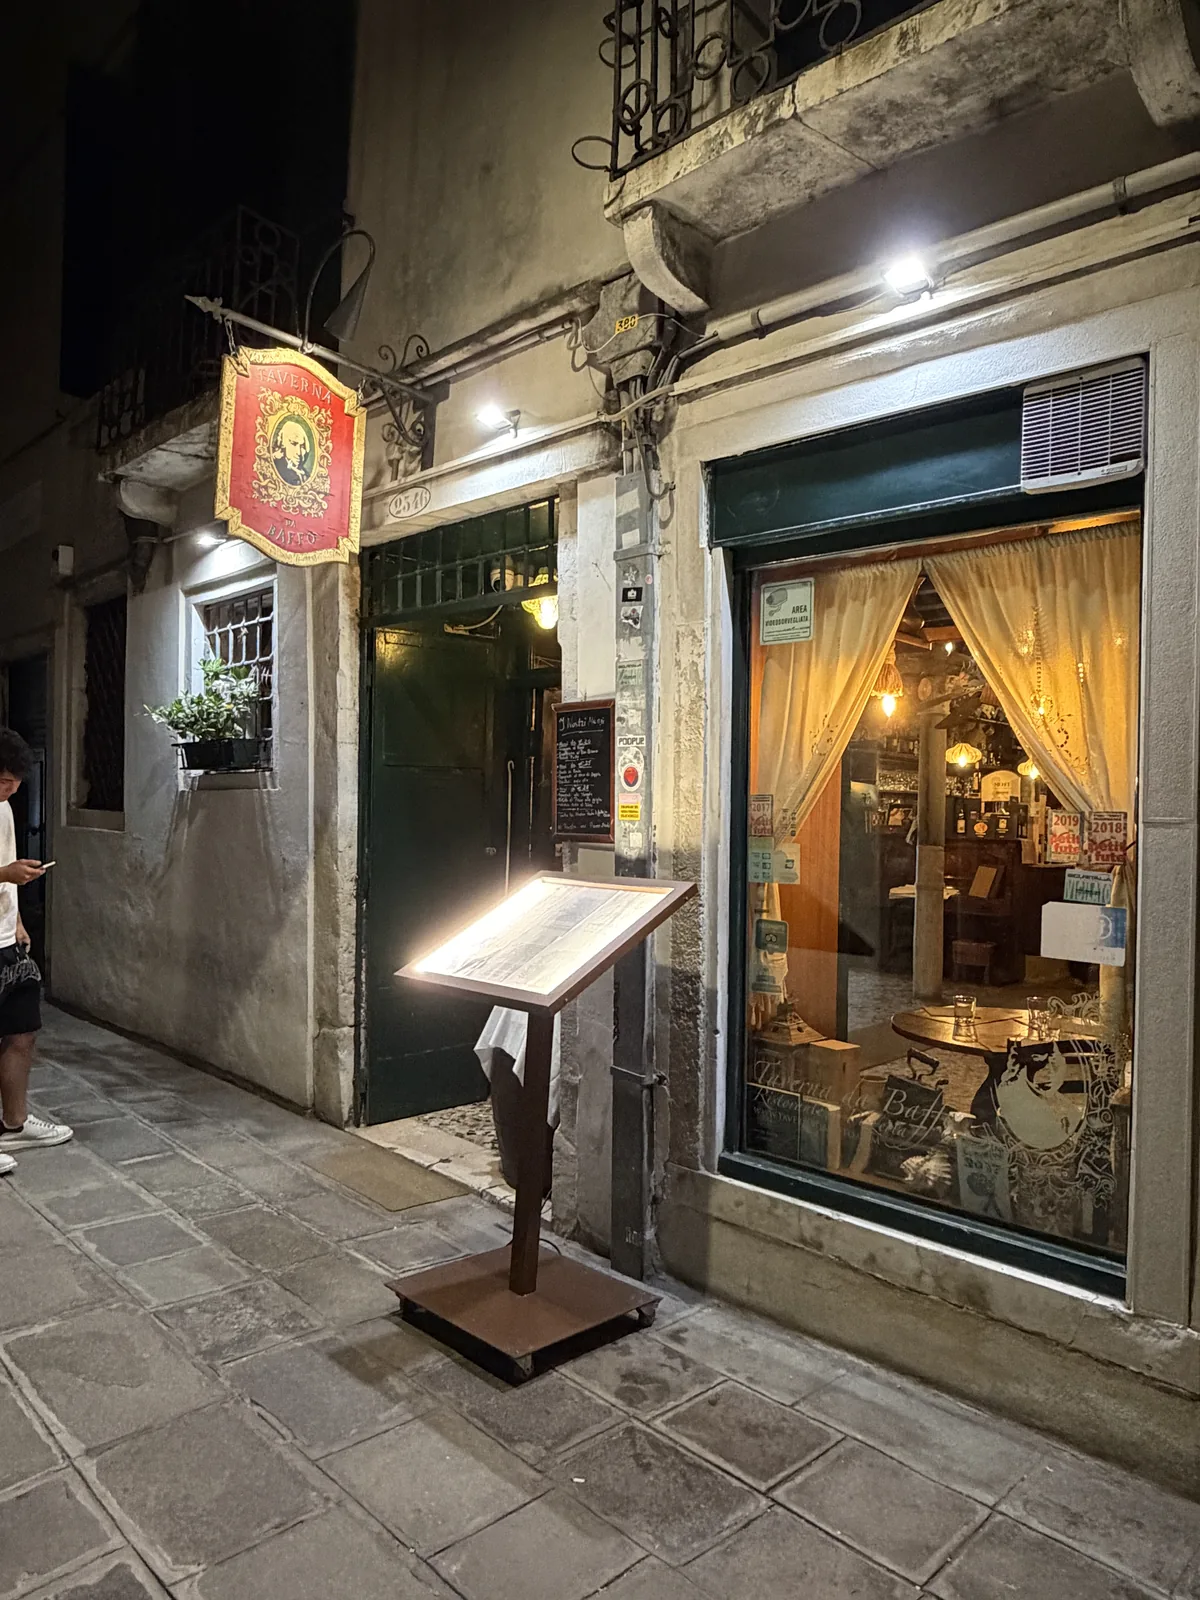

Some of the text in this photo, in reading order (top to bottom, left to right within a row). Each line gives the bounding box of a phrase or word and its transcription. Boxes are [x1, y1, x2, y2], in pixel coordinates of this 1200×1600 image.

[259, 368, 332, 404] TAVERNA
[267, 523, 318, 545] BAFFO
[791, 605, 808, 614] AREA
[752, 803, 770, 812] 2017
[1053, 814, 1079, 827] 2019
[1092, 821, 1122, 834] 2018
